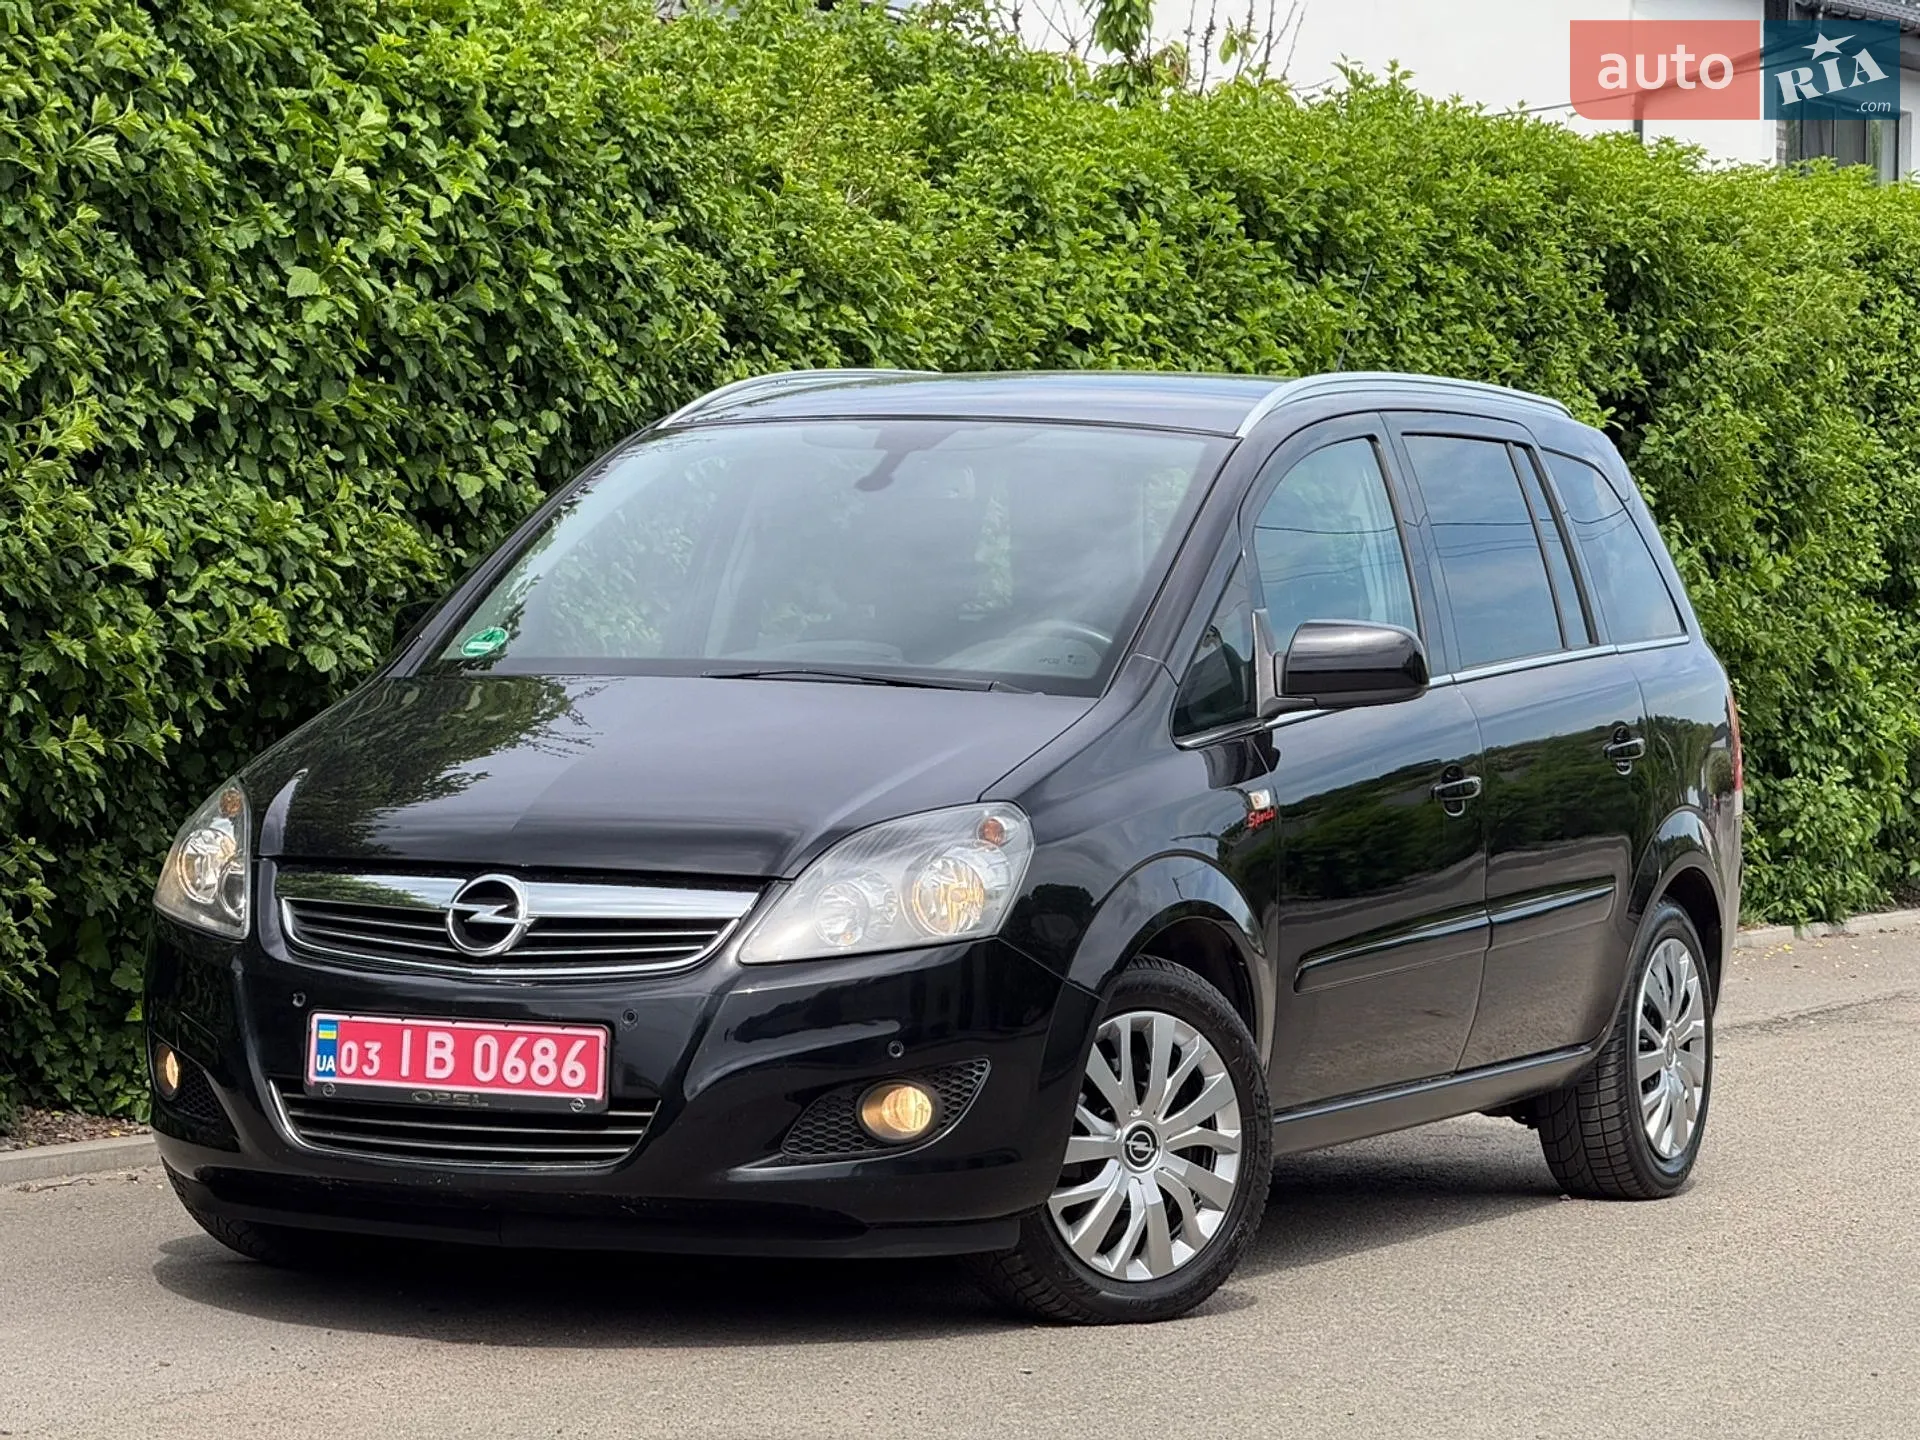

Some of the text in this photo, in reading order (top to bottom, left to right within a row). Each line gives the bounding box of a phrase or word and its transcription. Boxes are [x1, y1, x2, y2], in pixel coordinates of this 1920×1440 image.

[316, 1054, 336, 1072] UA
[340, 1028, 588, 1088] 03 IB 0686
[411, 1090, 488, 1107] OPEL
